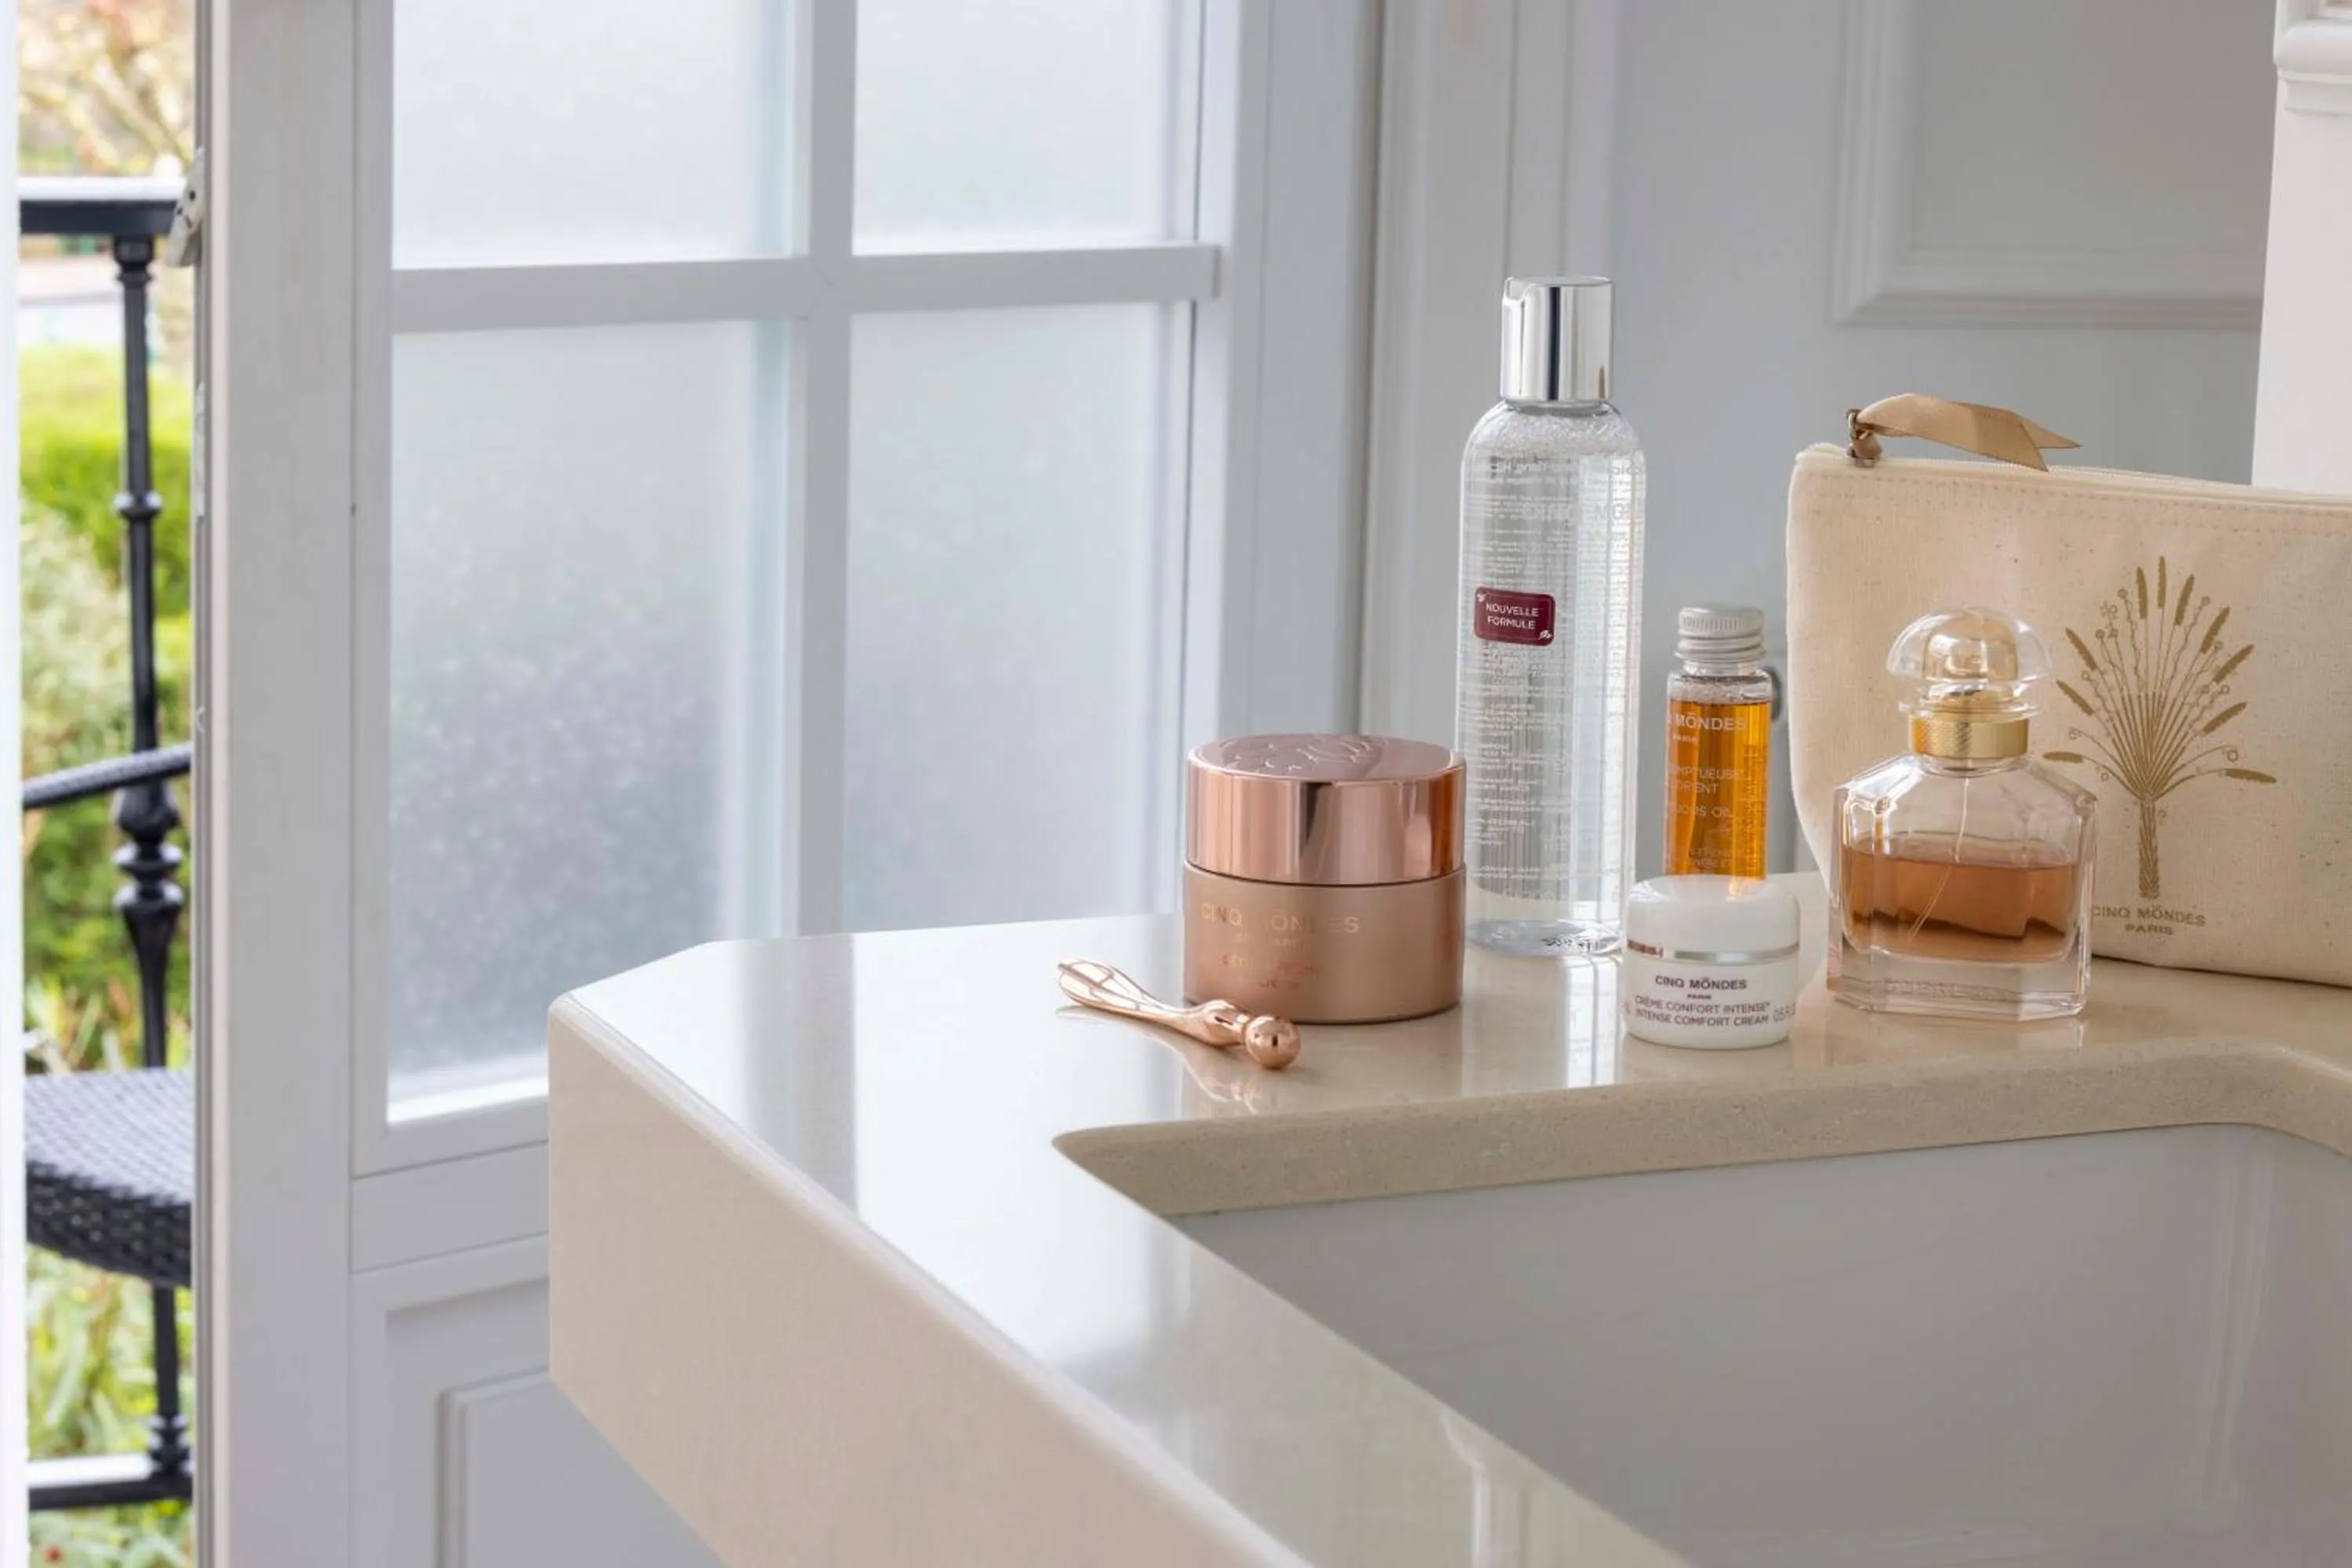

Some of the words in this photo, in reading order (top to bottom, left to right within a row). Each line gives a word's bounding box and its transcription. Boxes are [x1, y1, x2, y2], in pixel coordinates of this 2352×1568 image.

[1486, 603, 1539, 618] NOUVELLE
[1487, 615, 1537, 630] FORMULE
[2092, 905, 2130, 918] CINQ
[2124, 923, 2173, 936] PARIS
[1655, 975, 1684, 988] CINQ
[1666, 1001, 1719, 1014] CONFORT
[1674, 1014, 1730, 1027] COMFORT
[1733, 1014, 1769, 1027] CREAM
